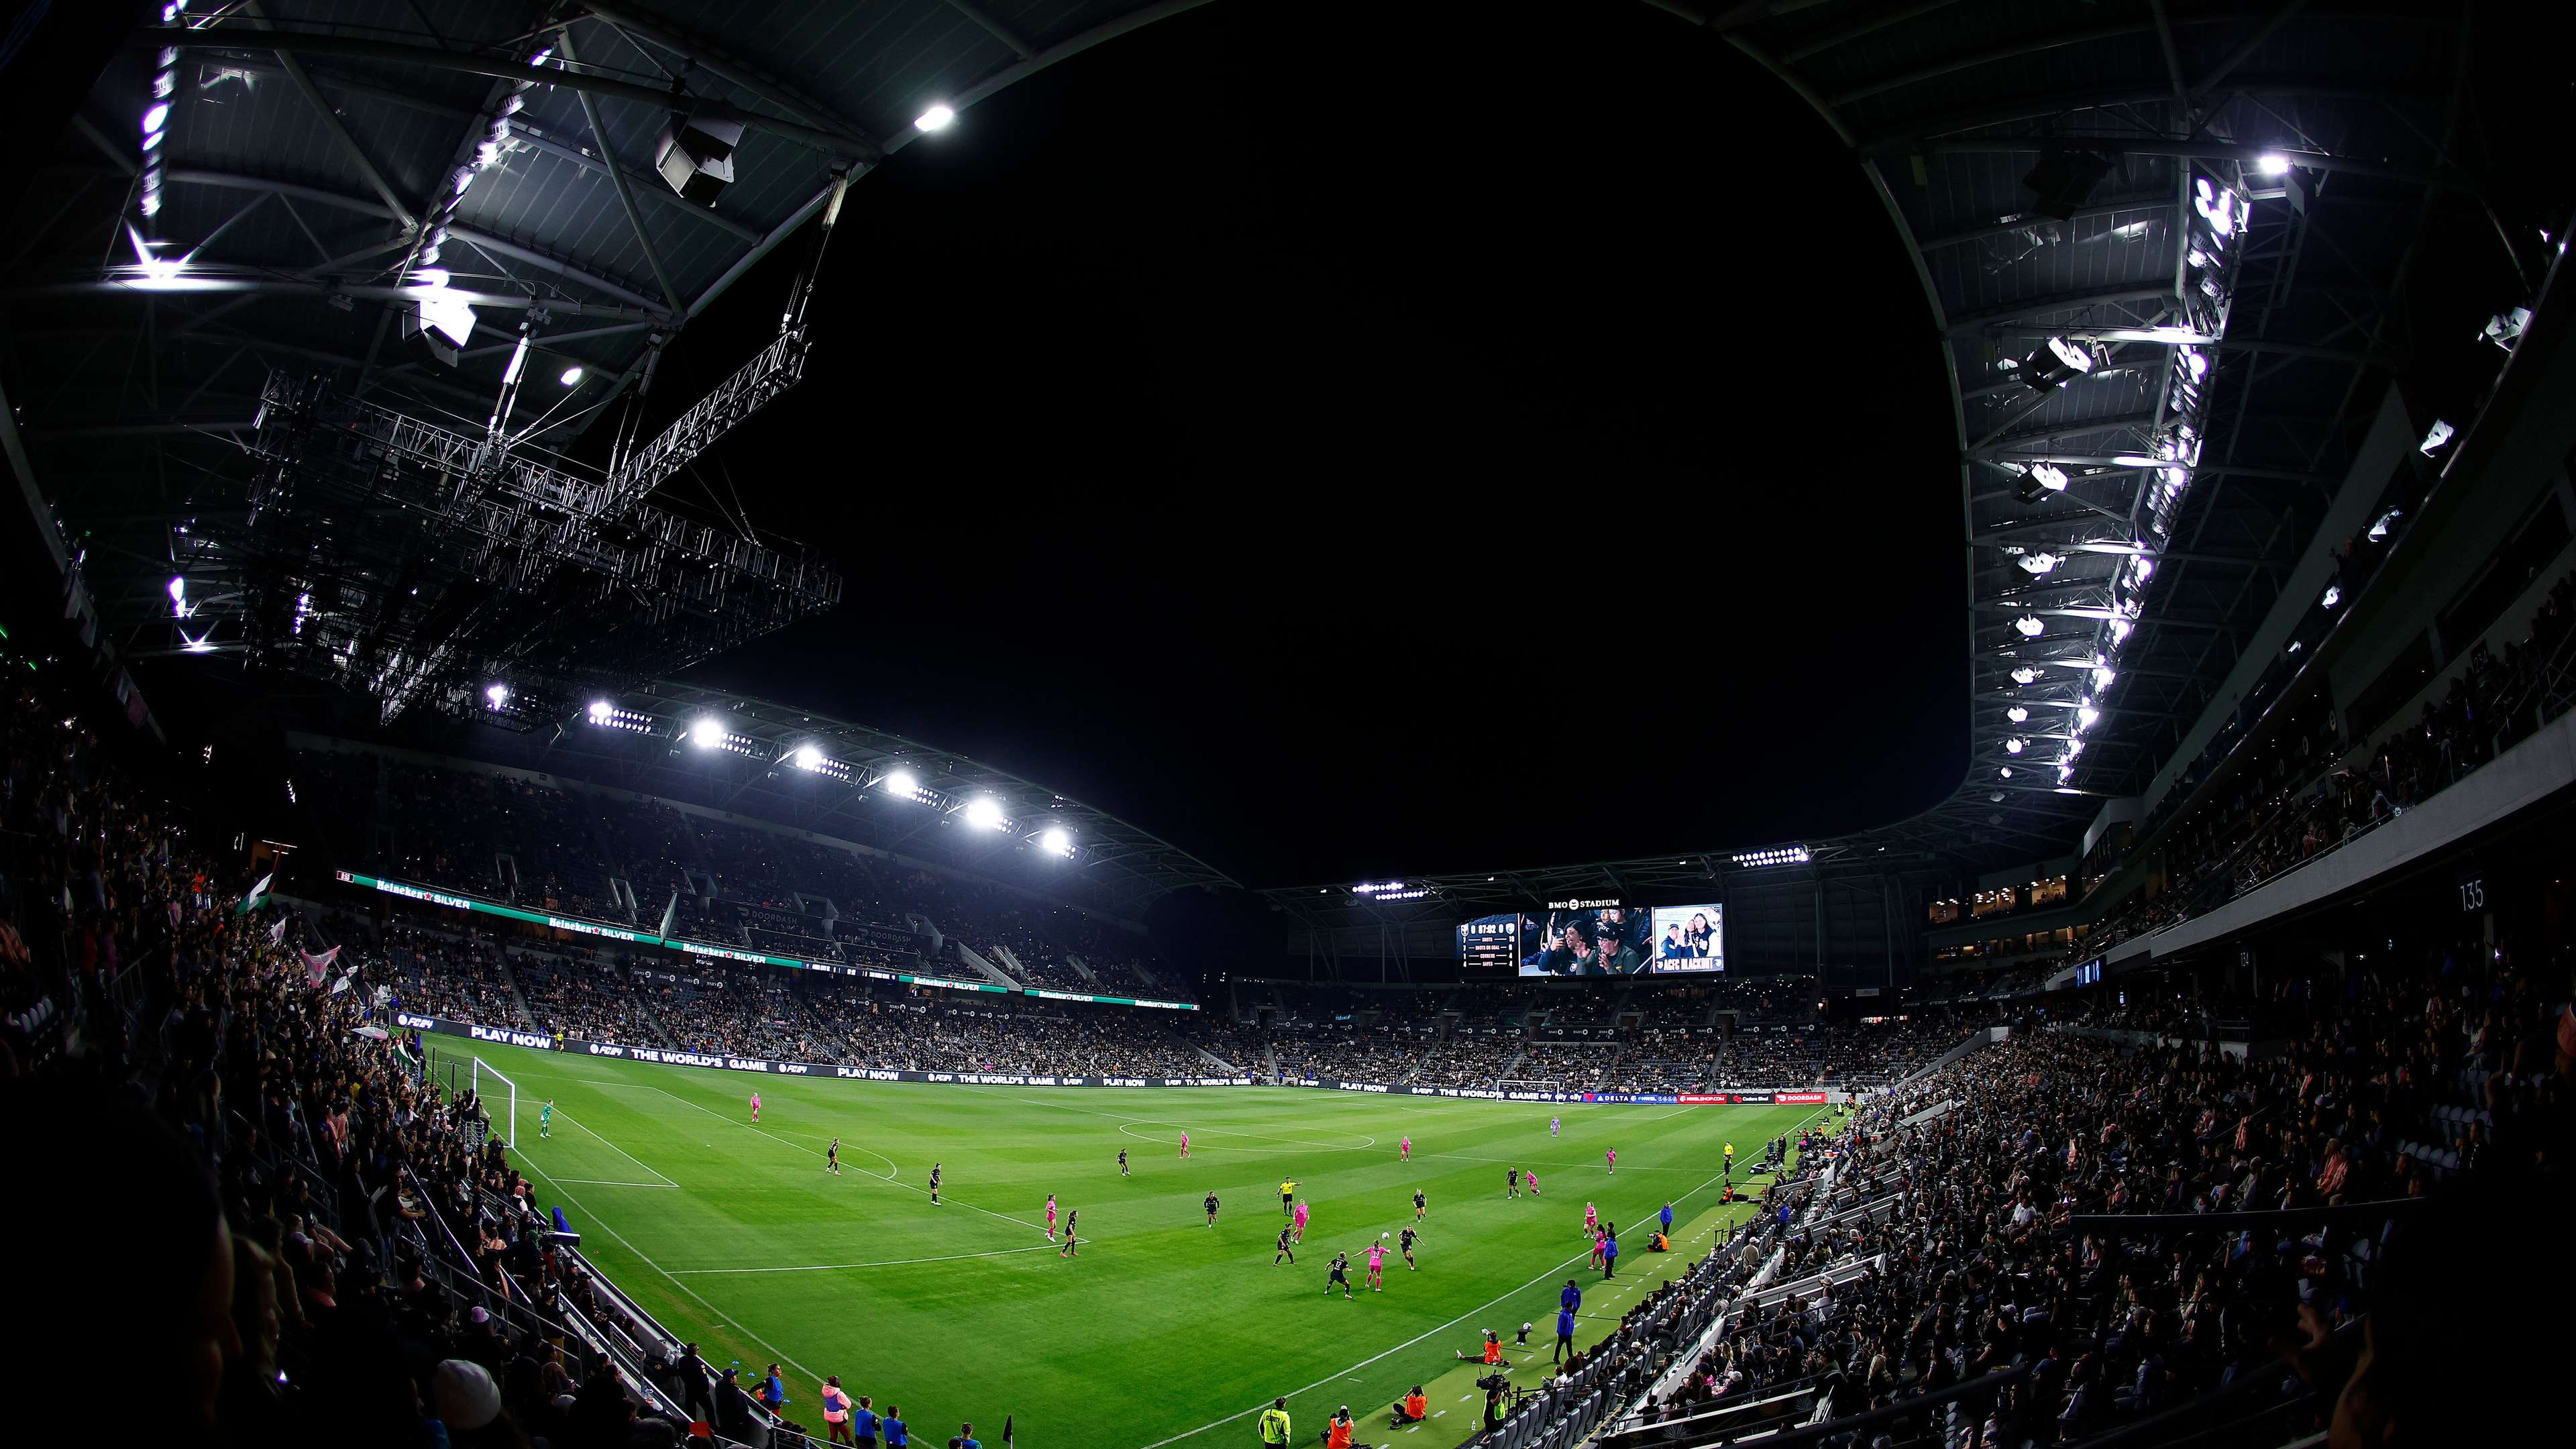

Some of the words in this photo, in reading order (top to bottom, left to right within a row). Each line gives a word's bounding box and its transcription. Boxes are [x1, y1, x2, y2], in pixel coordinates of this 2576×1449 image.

[376, 880, 423, 899] Heineken
[433, 894, 470, 910] SILVER
[2461, 879, 2483, 911] 135
[1580, 899, 1619, 907] STADIUM
[752, 910, 798, 924] DOORDASH
[549, 918, 591, 934] Heineken
[601, 928, 634, 941] SILVER
[871, 930, 911, 943] DOORDASH
[683, 943, 725, 957] Heineken
[734, 953, 766, 963] SILVER
[1664, 959, 1680, 971] ACFC
[1681, 957, 1713, 970] BLACKOUT
[914, 977, 947, 987] Heineken
[953, 983, 979, 991] SILVER
[1039, 991, 1068, 999] Heineken
[407, 1017, 433, 1028] FC24
[471, 1026, 511, 1042] PLAY
[512, 1034, 551, 1049] NOW
[631, 1049, 659, 1061] THE
[661, 1051, 724, 1067] WORLD'S
[729, 1059, 767, 1071] GAME
[837, 1068, 869, 1079] PLAY
[869, 1071, 899, 1081] NOW
[958, 1075, 979, 1083] THE
[979, 1075, 1024, 1084] WORLD'S
[1028, 1077, 1056, 1085] GAME
[1125, 1079, 1146, 1087] NOW
[1340, 1082, 1364, 1091] PLAY
[1364, 1084, 1388, 1093] NOW
[1439, 1088, 1458, 1096] THE
[1459, 1089, 1505, 1099] WORLD'S
[1509, 1092, 1539, 1100] GAME
[1540, 1093, 1552, 1102] ally
[1570, 1093, 1582, 1102] ally
